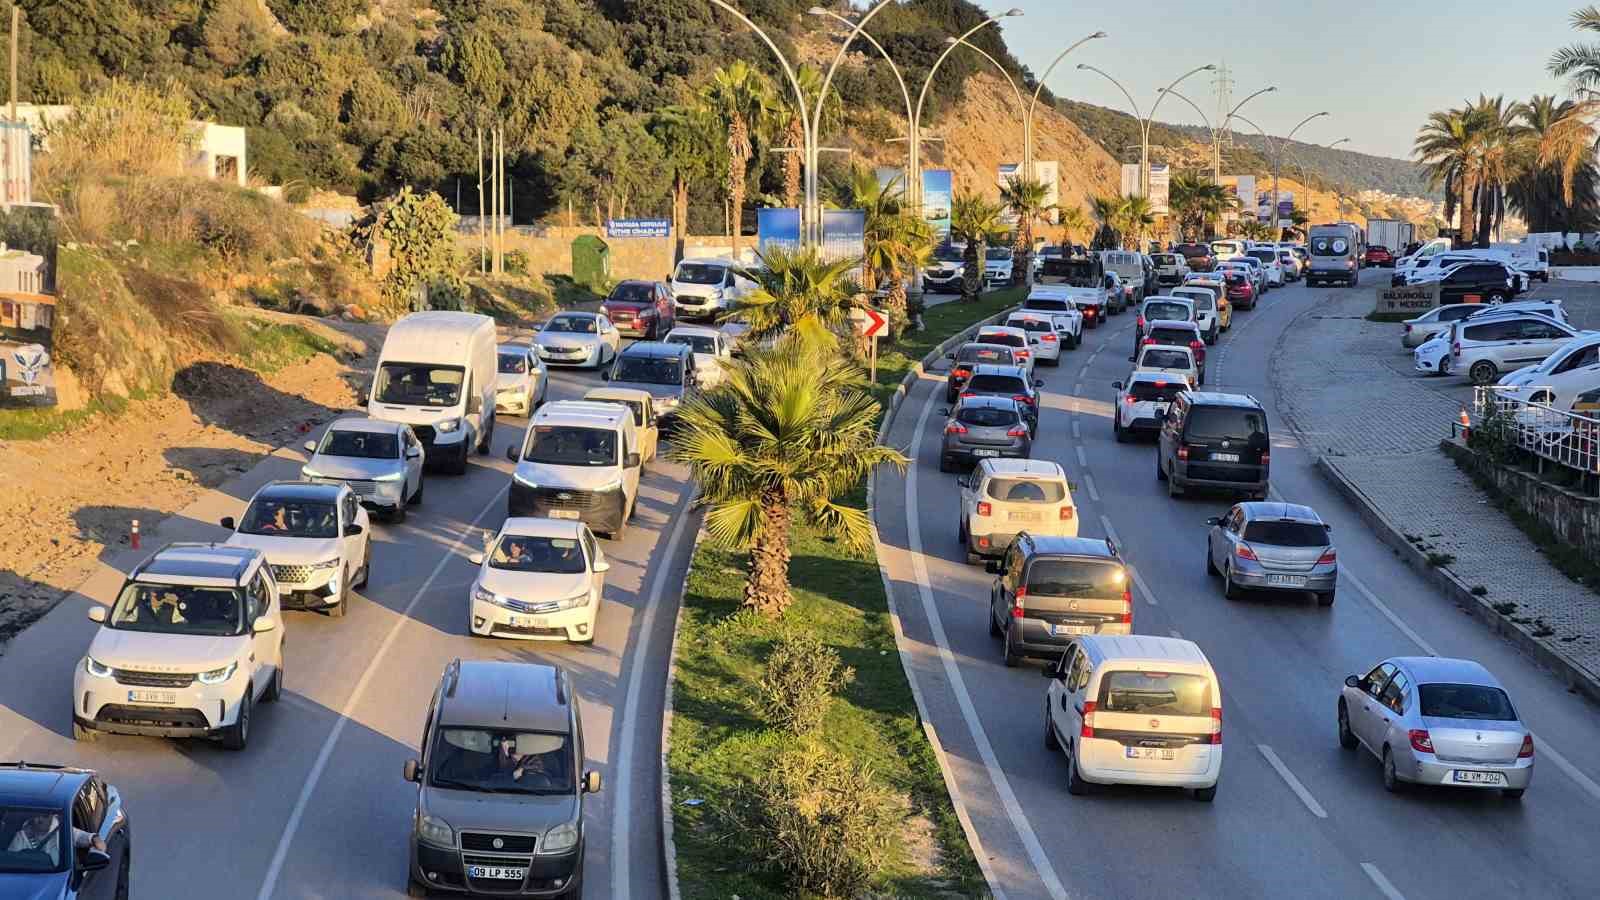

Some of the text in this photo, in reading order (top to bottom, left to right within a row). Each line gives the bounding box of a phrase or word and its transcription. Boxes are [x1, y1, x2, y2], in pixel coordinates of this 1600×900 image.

[474, 867, 522, 879] 09 LP 555
